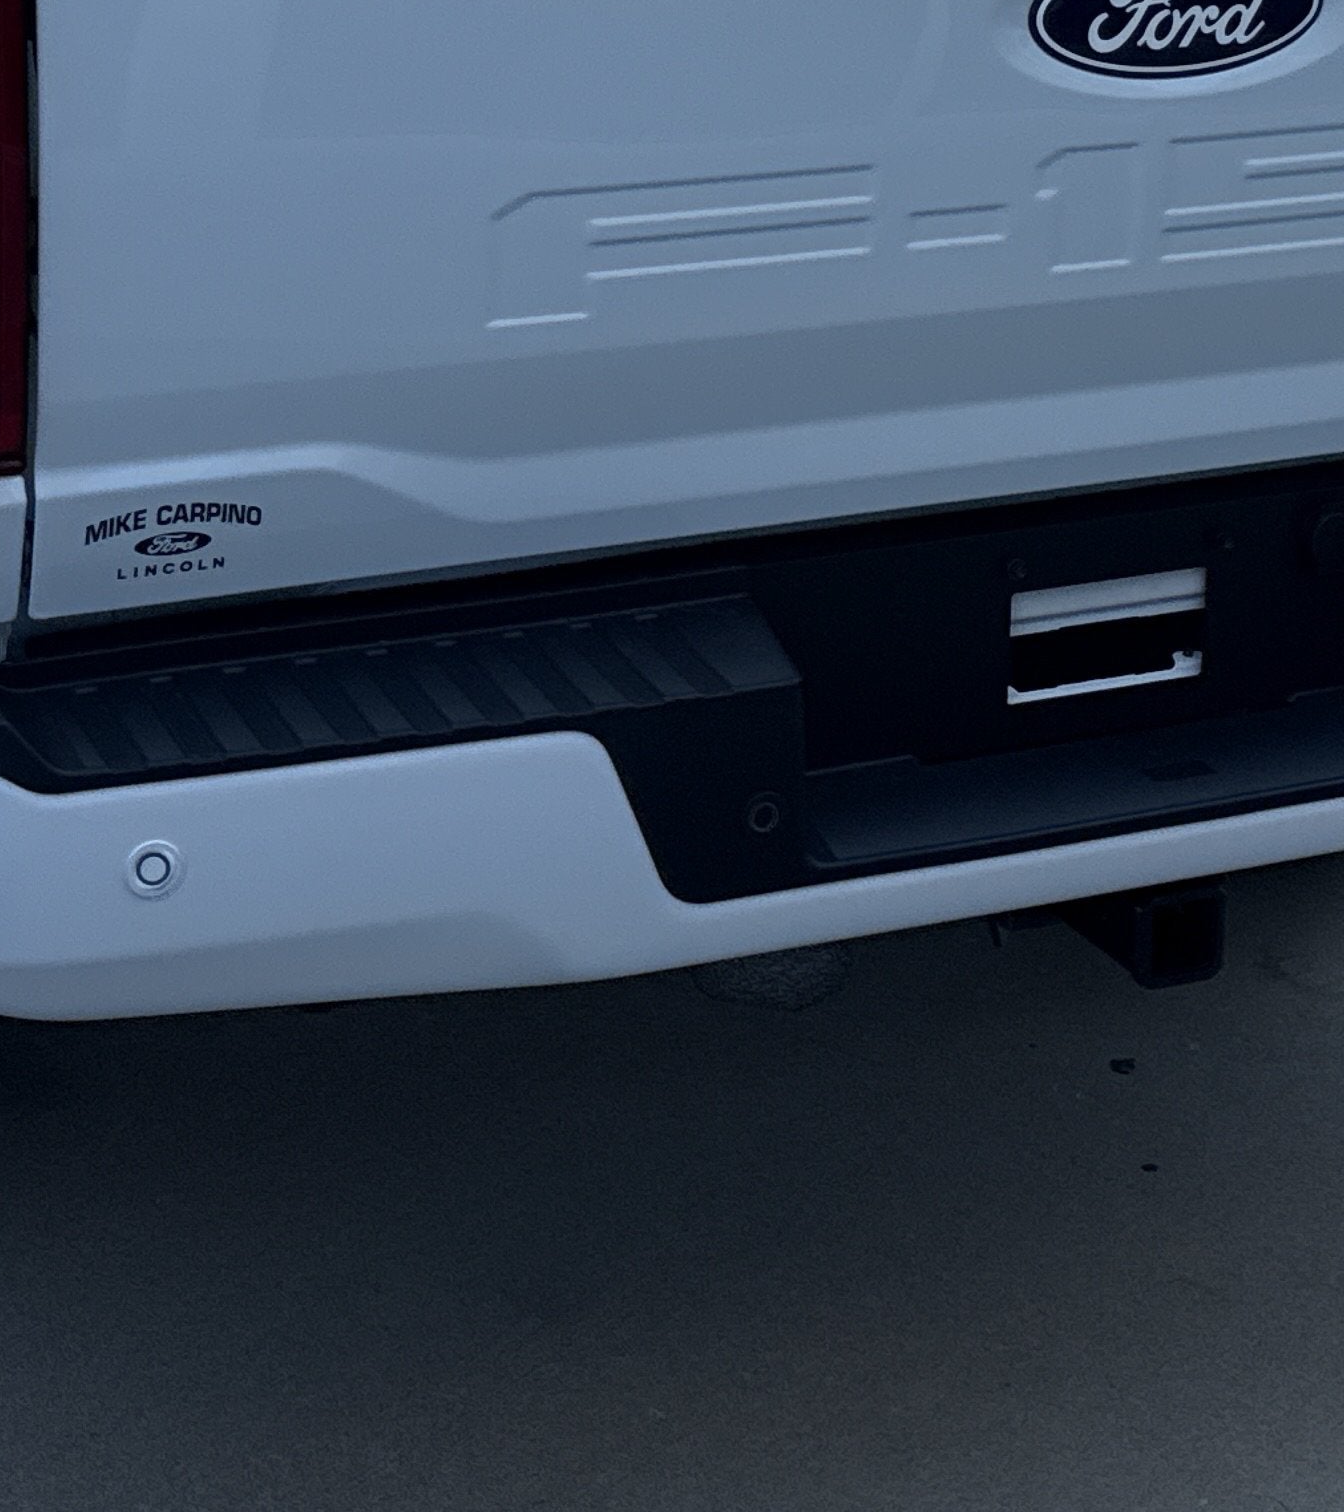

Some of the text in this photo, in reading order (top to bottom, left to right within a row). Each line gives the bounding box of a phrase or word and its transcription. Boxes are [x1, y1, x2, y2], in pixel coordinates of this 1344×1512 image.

[85, 502, 263, 545] MIKE CARPINO
[146, 532, 200, 555] Ford
[117, 557, 225, 580] LINCOLN
